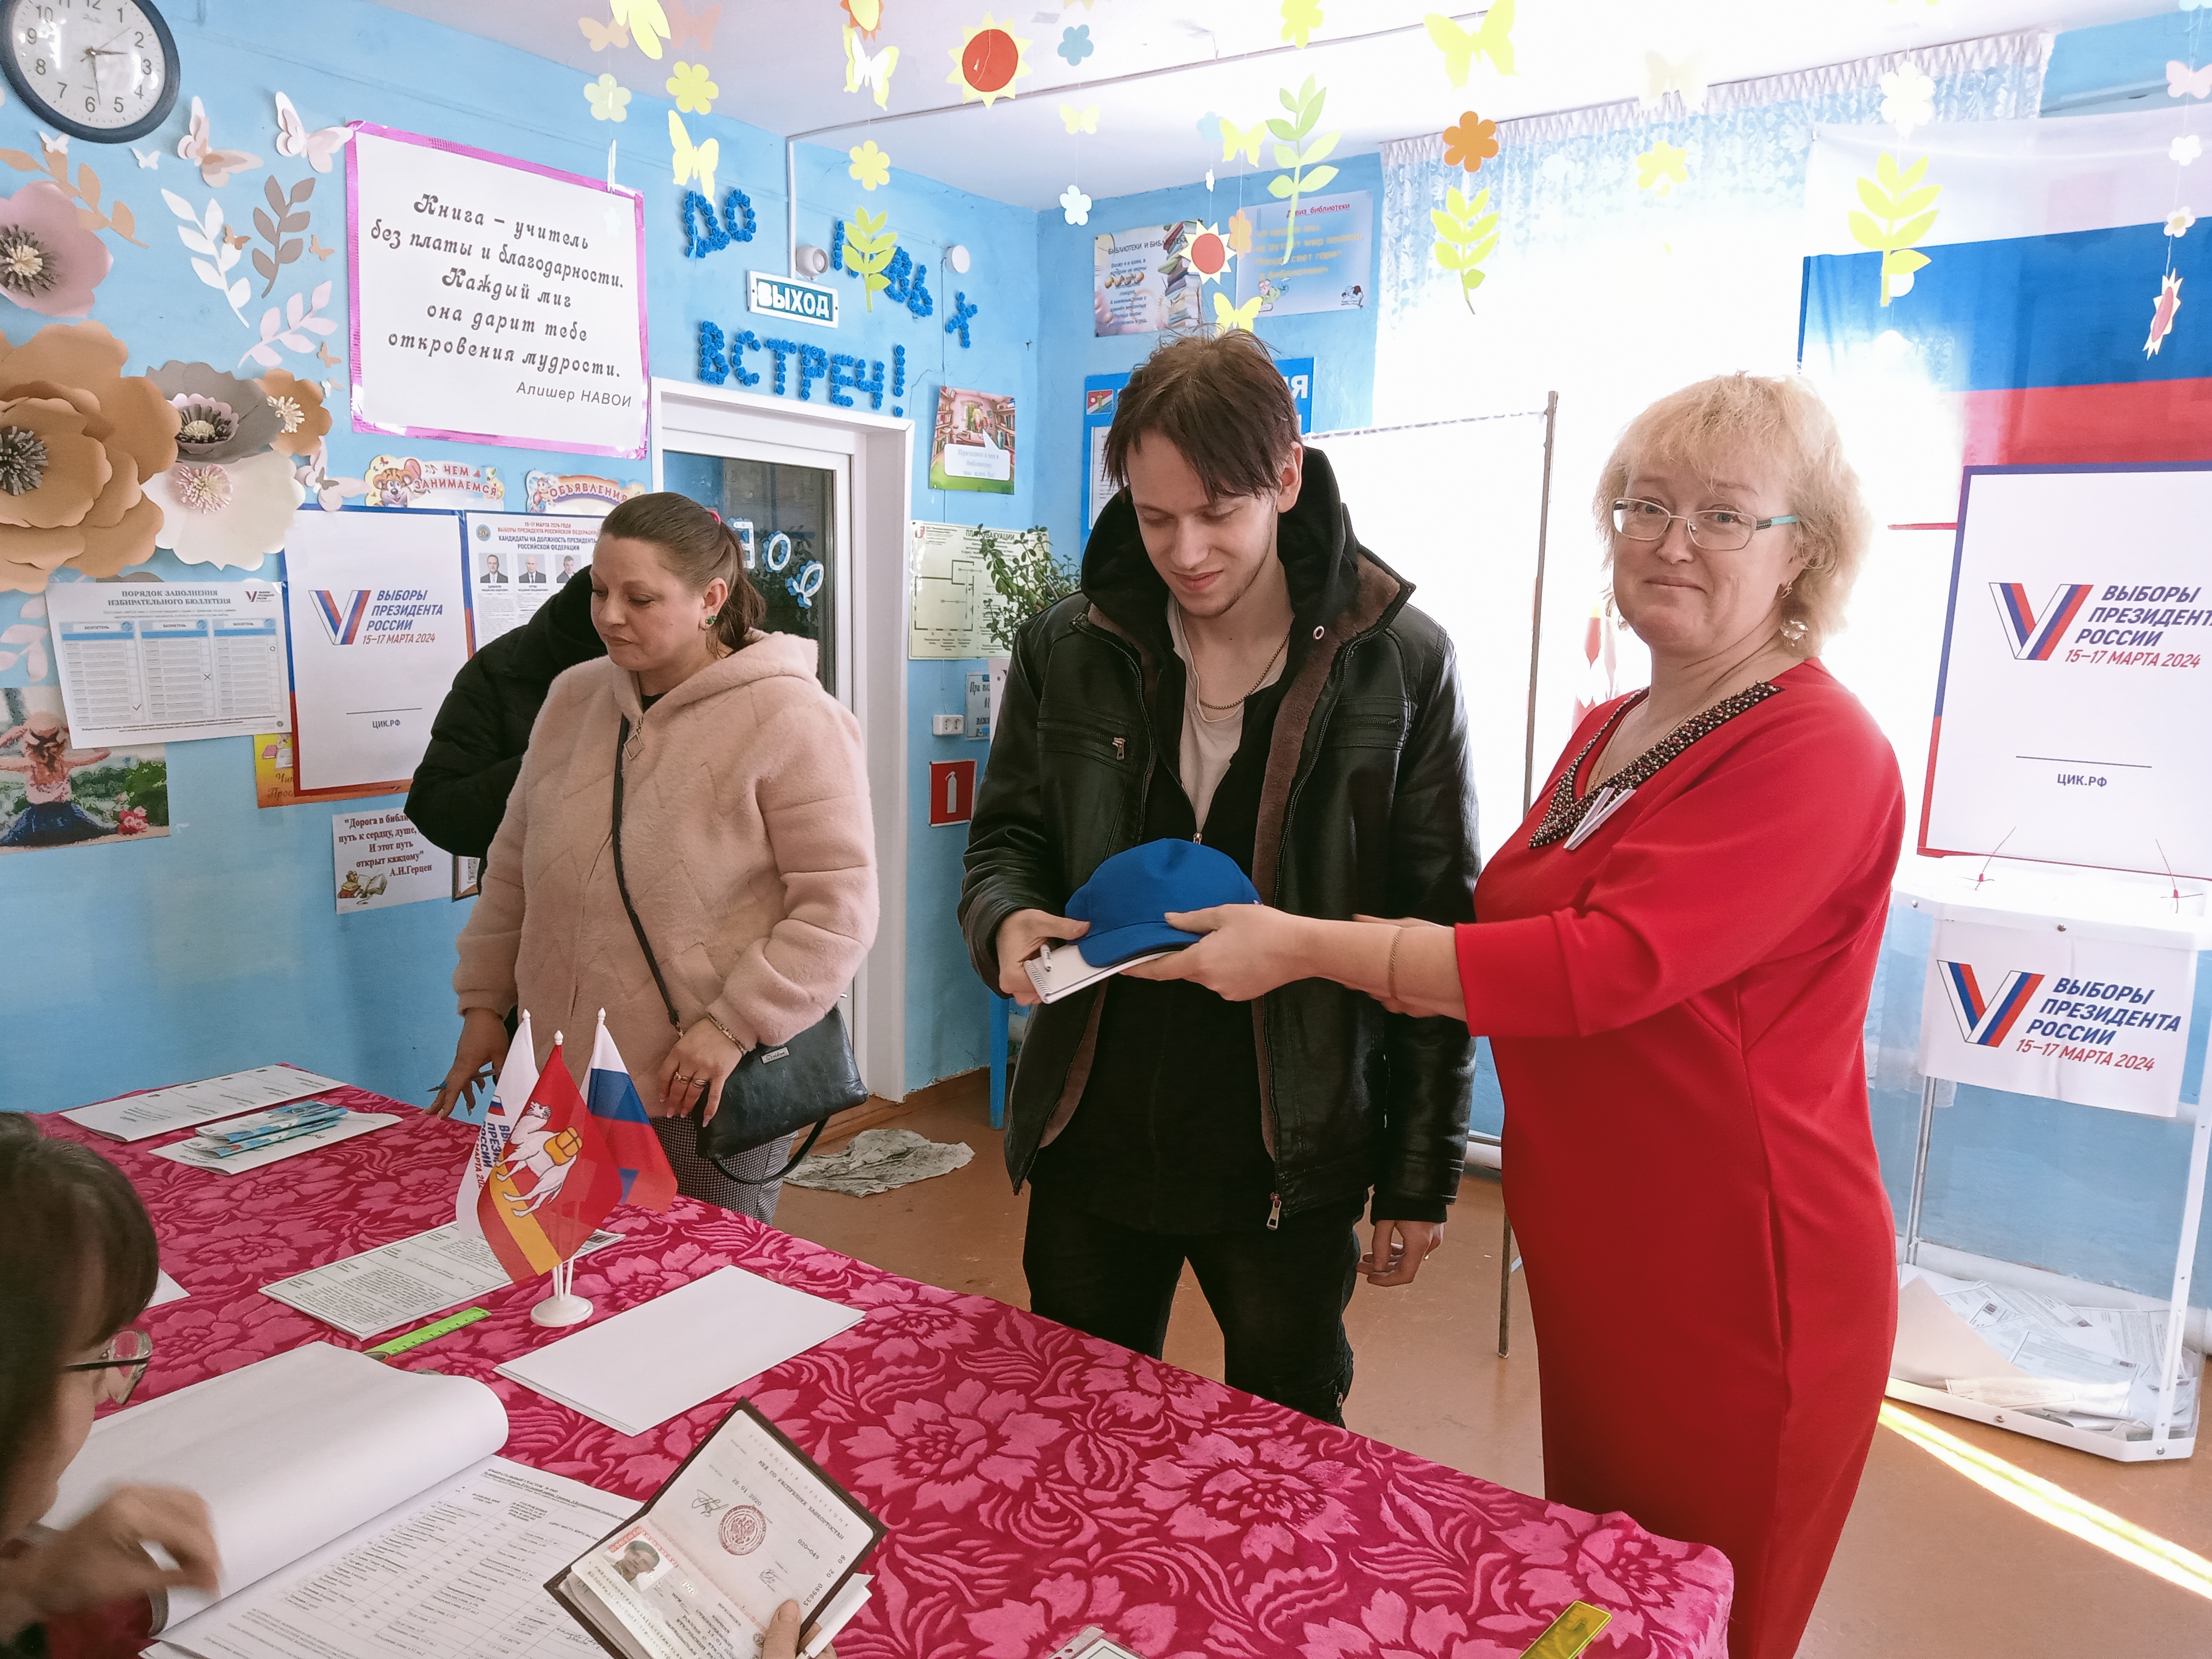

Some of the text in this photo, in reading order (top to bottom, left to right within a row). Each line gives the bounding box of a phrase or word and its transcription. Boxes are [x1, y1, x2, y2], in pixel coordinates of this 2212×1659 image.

[118, 7, 123, 23] 1
[27, 28, 37, 44] 9
[135, 31, 144, 48] 2
[36, 58, 46, 75] 8
[142, 59, 152, 75] 3
[57, 81, 68, 98] 7
[133, 85, 144, 99] 4
[85, 96, 96, 113] 6
[114, 97, 124, 113] 5
[1310, 204, 1350, 214] библиотеки
[413, 194, 484, 226] Книга
[514, 220, 589, 249] учитель
[684, 189, 757, 258] ДО
[371, 219, 624, 289] без платы и благодарности.
[1108, 244, 1142, 255] БИБЛИОТЕКИ
[441, 267, 572, 308] Каждый миг
[757, 281, 831, 319] ВЫХОД
[427, 304, 588, 342] она дарит тебе
[388, 331, 620, 378] откровения мудрости.
[700, 321, 906, 417] ВСТРЕЧ!
[516, 381, 632, 408] Алишер НАВОИ
[443, 464, 469, 477] ЧЕМ
[414, 478, 498, 497] ЗАНИМАЕМСЯ
[549, 483, 629, 503] ОБЪЯВЛЕНИЯ
[376, 590, 428, 601] ВЫБОРЫ
[2101, 585, 2202, 603] ВЫБОРЫ
[371, 604, 443, 617] ПРЕЗИДЕНТА
[2088, 607, 2212, 627] ПРЕЗИДЕНТ
[366, 619, 413, 631] РОССИИ
[386, 634, 414, 643] МАРТА
[415, 633, 435, 643] 2024
[2074, 629, 2164, 647] РОССИИ
[2106, 650, 2160, 666] МАРТА
[2160, 653, 2201, 668] 2024
[372, 719, 400, 729] ЦИК.РФ
[2057, 773, 2108, 789] ЦИК.РФ
[345, 818, 378, 830] "Дорога
[386, 814, 409, 823] библи
[339, 833, 357, 844] путь
[366, 830, 394, 841] сердцу,
[395, 827, 417, 837] душе,
[369, 840, 413, 852] И этот путь
[356, 850, 424, 868] открыт каждому"
[389, 864, 432, 877] А.И.Герцен
[2052, 977, 2155, 1005] ВЫБОРЫ
[2039, 998, 2181, 1032] ПРЕЗИДЕНТА
[2026, 1018, 2117, 1046] РОССИИ
[2059, 1045, 2114, 1066] МАРТА
[2114, 1053, 2155, 1071] 2024
[487, 1122, 502, 1162] ПРЕЗИ
[498, 1124, 511, 1142] ВЫ
[796, 1538, 821, 1561] 020-049
